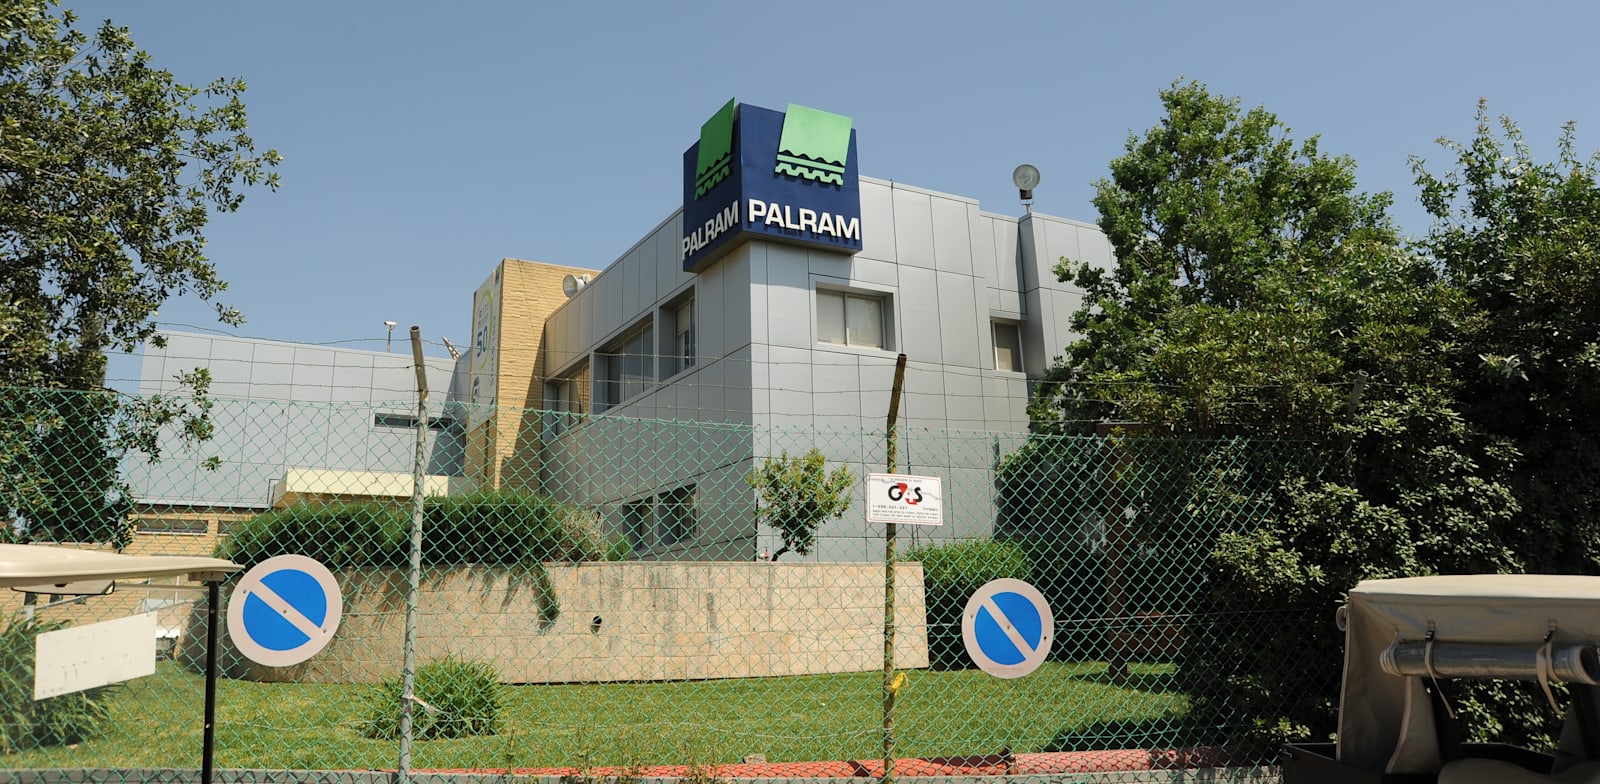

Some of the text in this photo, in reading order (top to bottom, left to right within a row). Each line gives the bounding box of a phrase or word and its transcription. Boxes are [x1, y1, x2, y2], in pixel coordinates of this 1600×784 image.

[682, 200, 739, 260] PALRAM
[748, 198, 860, 241] PALRAM
[476, 326, 488, 358] 50
[888, 482, 923, 505] G4S
